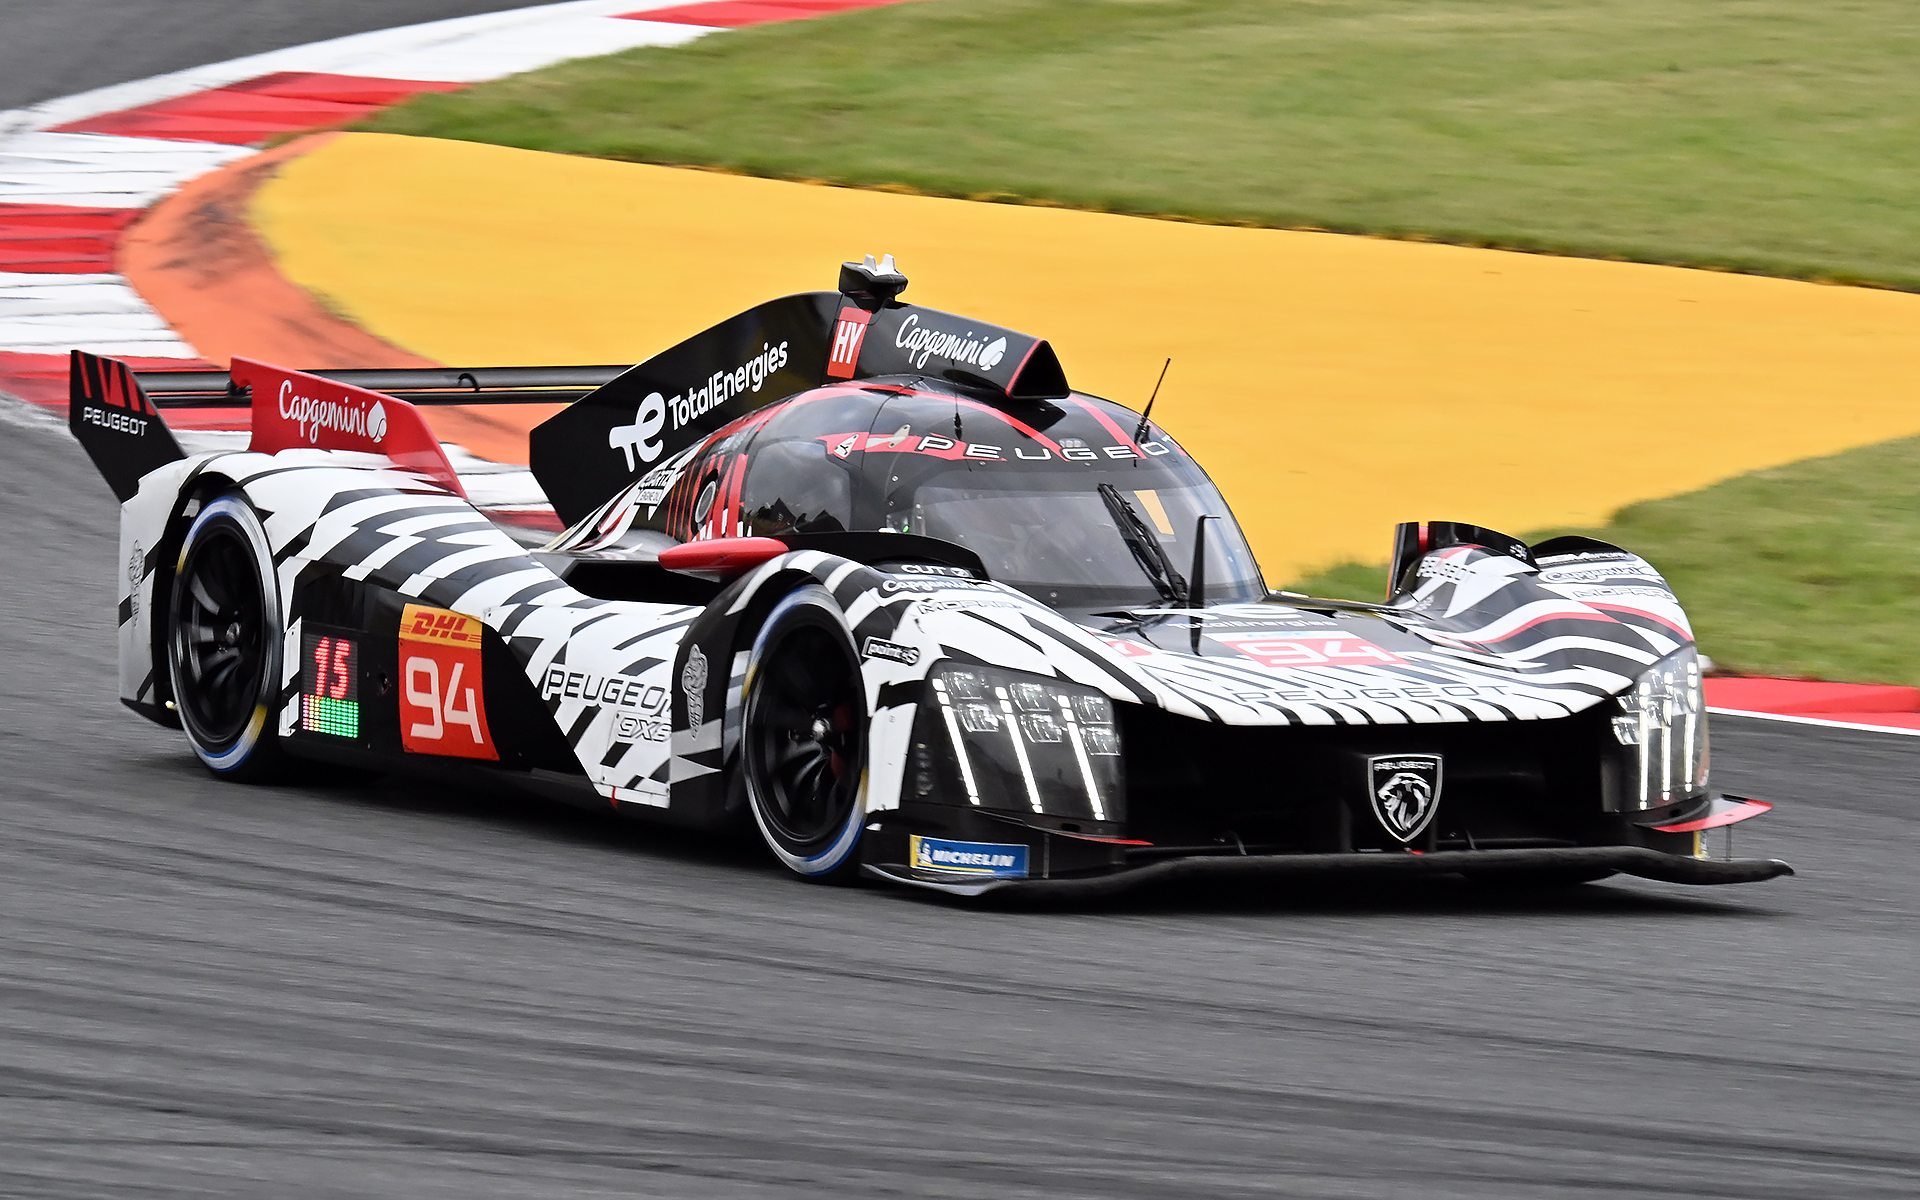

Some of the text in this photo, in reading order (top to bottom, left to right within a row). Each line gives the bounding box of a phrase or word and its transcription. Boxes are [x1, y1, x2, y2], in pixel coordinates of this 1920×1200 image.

[832, 320, 865, 366] HY
[895, 313, 984, 370] Capgemini
[668, 340, 789, 431] TotalEnergies
[82, 406, 148, 437] PEUGEOT
[278, 378, 368, 444] Capgemini
[917, 434, 1181, 461] PEUGEOT
[901, 564, 946, 575] CUT
[410, 611, 469, 641] DHL
[315, 636, 351, 700] 15
[1236, 640, 1398, 663] 94
[406, 656, 484, 744] 94
[545, 669, 671, 712] PEUGEO
[1232, 685, 1508, 702] PEUGEOT
[932, 849, 1016, 867] MICHELIN
